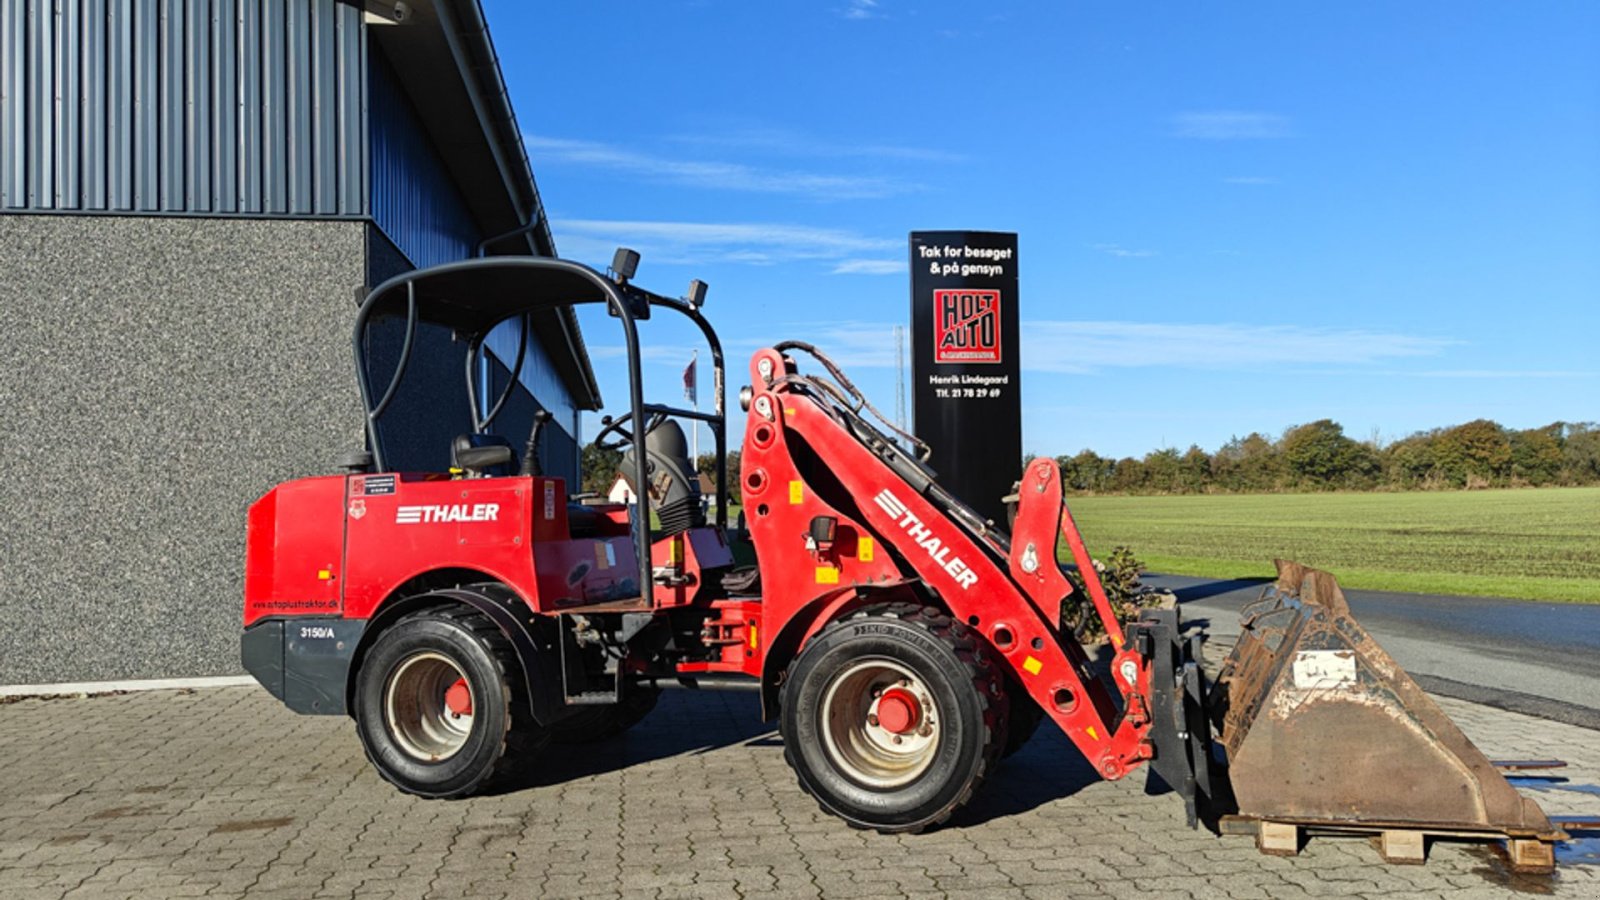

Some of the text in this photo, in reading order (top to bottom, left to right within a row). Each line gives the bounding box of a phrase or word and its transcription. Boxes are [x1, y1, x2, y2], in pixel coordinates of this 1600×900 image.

[919, 245, 1012, 261] Tak for besøget
[930, 261, 1003, 277] & på gensyn
[942, 294, 994, 331] HOLT
[941, 311, 996, 348] AUTO
[929, 375, 1009, 386] Henrik Lindegaard
[935, 388, 1001, 398] Tlf. 21 78 29 69
[421, 503, 500, 523] THALER
[899, 510, 979, 590] THALER
[300, 626, 335, 639] 3150/A
